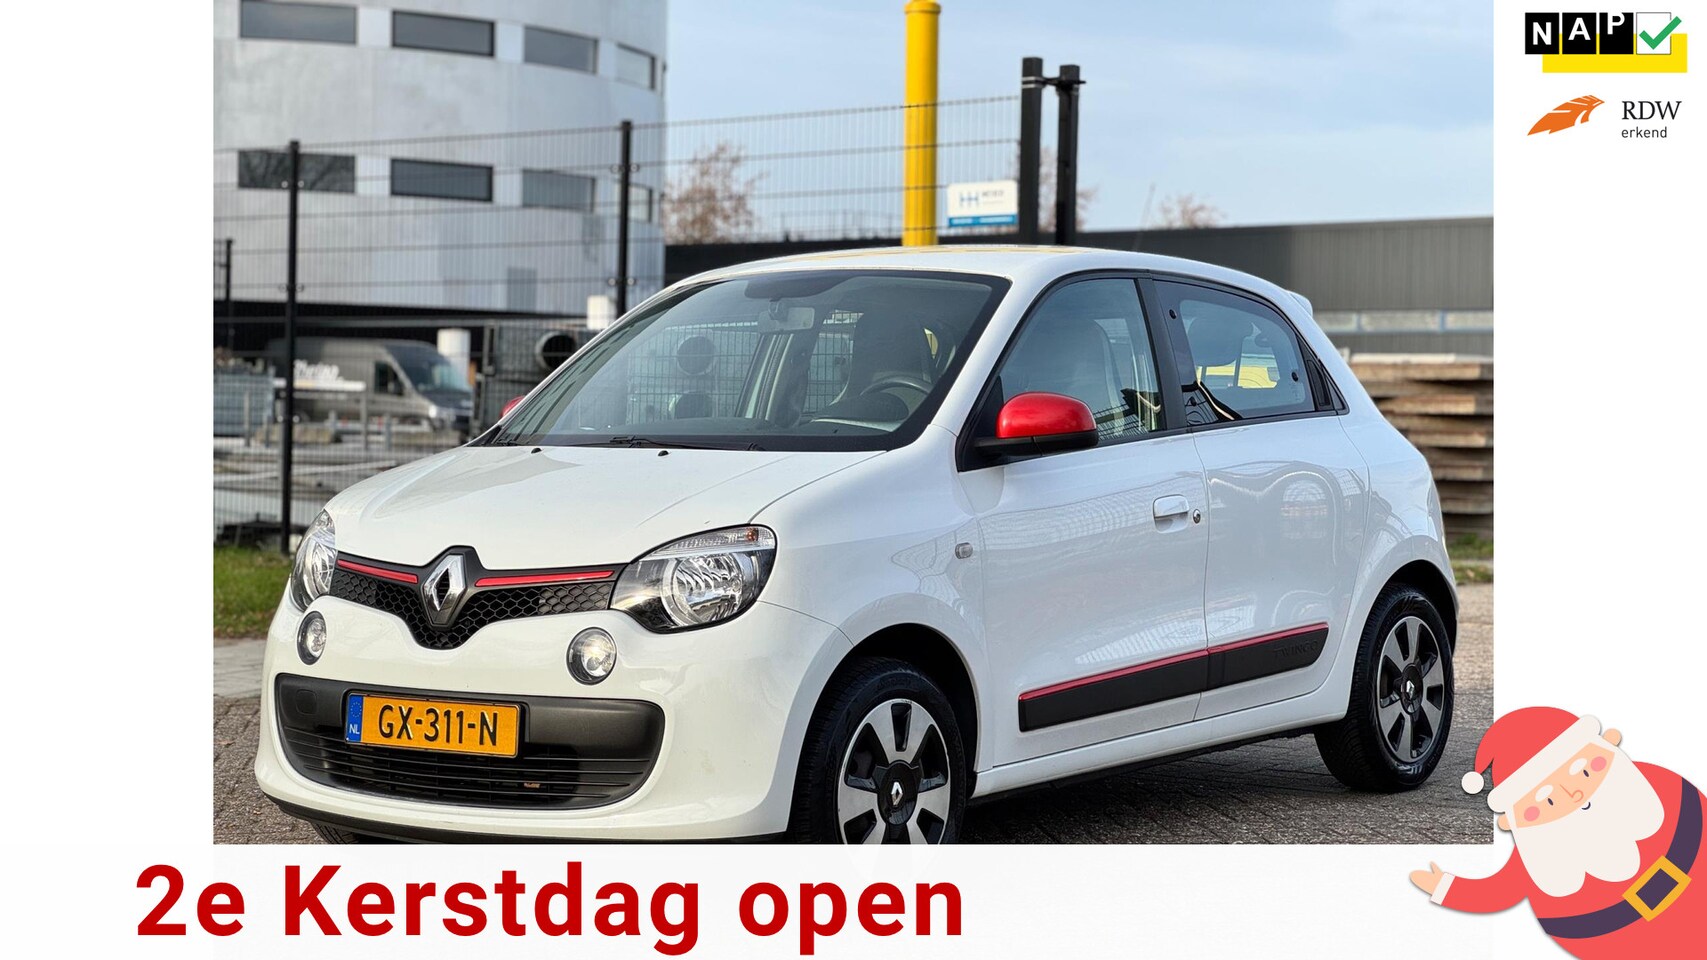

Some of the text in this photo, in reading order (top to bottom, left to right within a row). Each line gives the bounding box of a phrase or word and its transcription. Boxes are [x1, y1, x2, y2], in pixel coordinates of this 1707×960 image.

[1273, 639, 1319, 658] TWINGO
[349, 724, 360, 736] NL
[378, 704, 499, 747] GX-311-N
